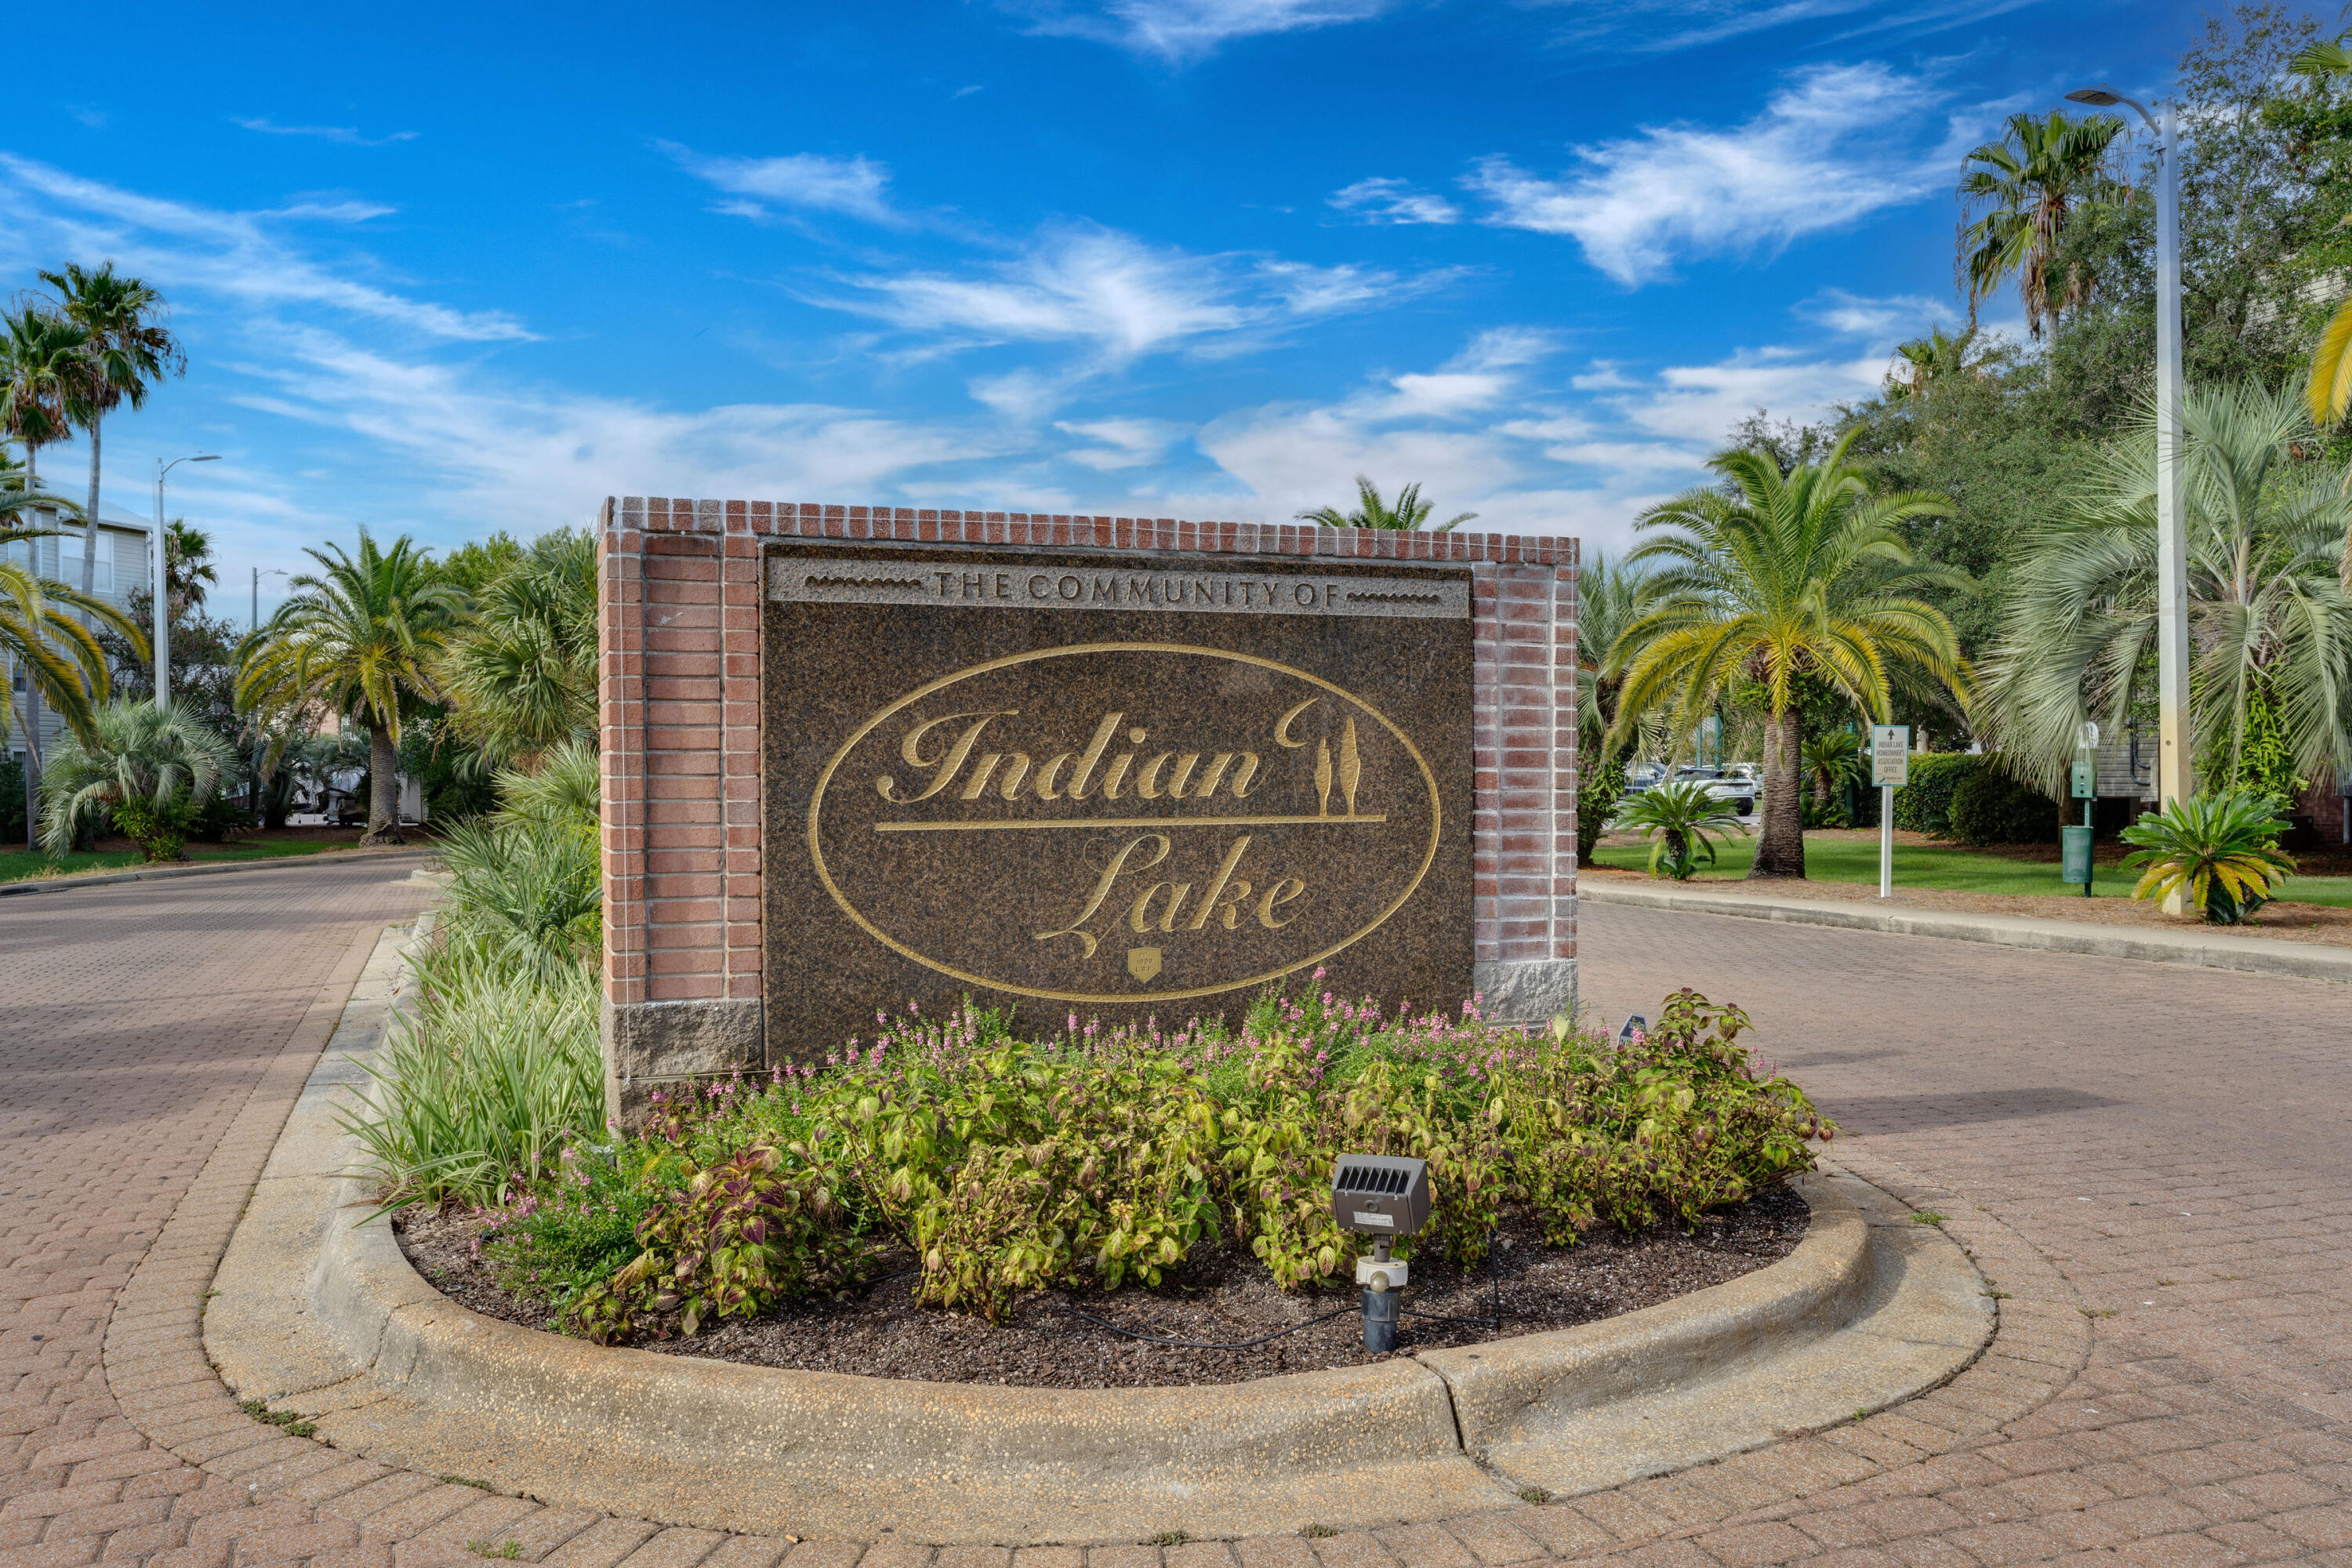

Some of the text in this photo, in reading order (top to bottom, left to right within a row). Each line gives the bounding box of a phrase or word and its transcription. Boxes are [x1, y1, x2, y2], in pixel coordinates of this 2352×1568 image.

[933, 571, 1338, 608] THE COMMUNITY OF
[876, 710, 1276, 804] Indian
[1033, 833, 1319, 959] Lake
